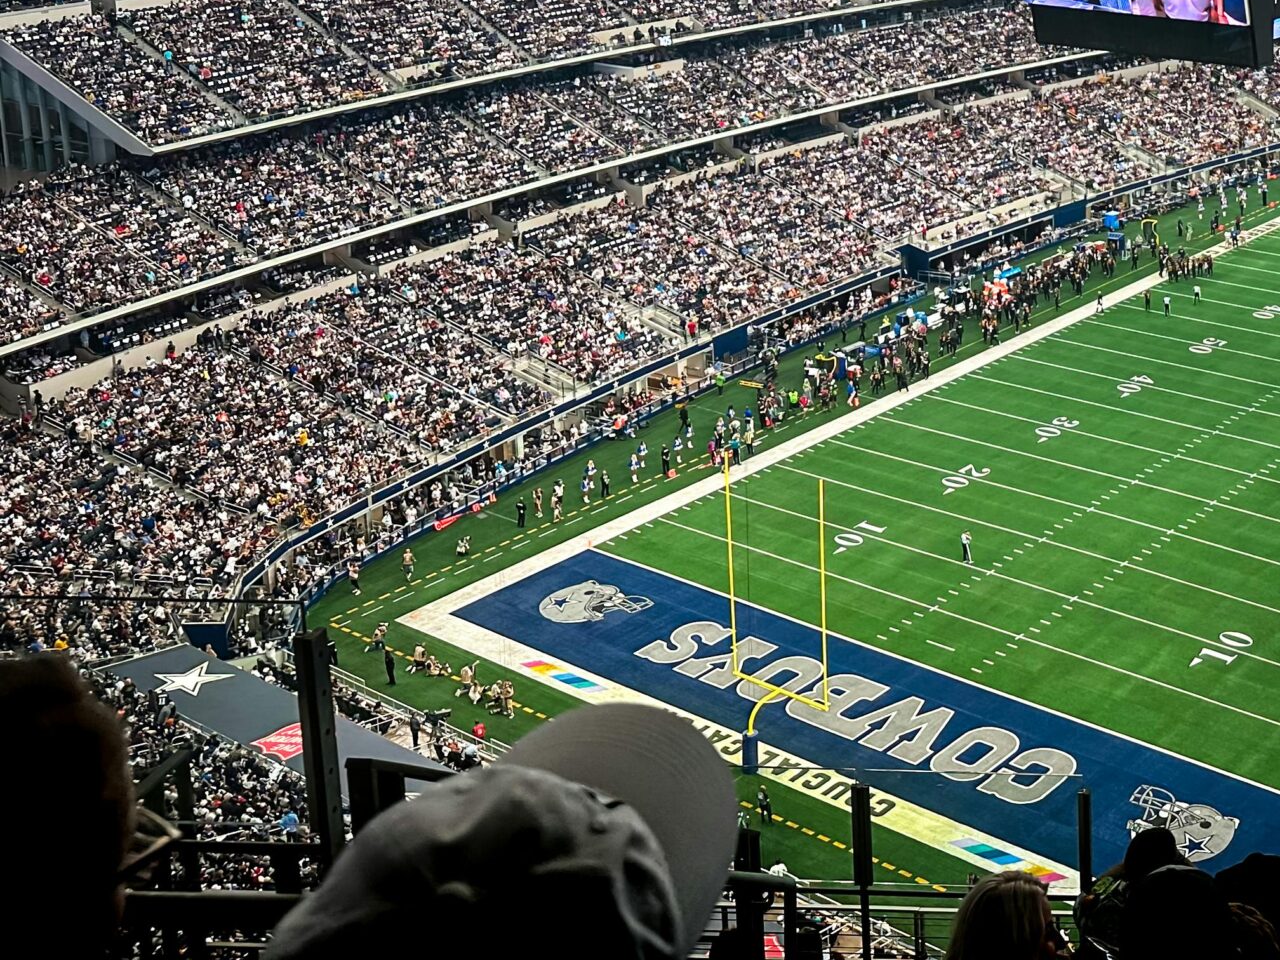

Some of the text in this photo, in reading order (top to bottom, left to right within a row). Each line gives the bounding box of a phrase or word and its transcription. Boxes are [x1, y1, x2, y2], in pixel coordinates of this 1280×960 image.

[1189, 337, 1228, 354] 50
[1116, 375, 1154, 393] 40
[1035, 416, 1080, 437] 30
[941, 464, 991, 488] 20
[833, 520, 888, 546] 10
[1199, 631, 1254, 665] 10
[634, 620, 1078, 804] COWBOYS
[762, 749, 896, 817] CUCIAL
